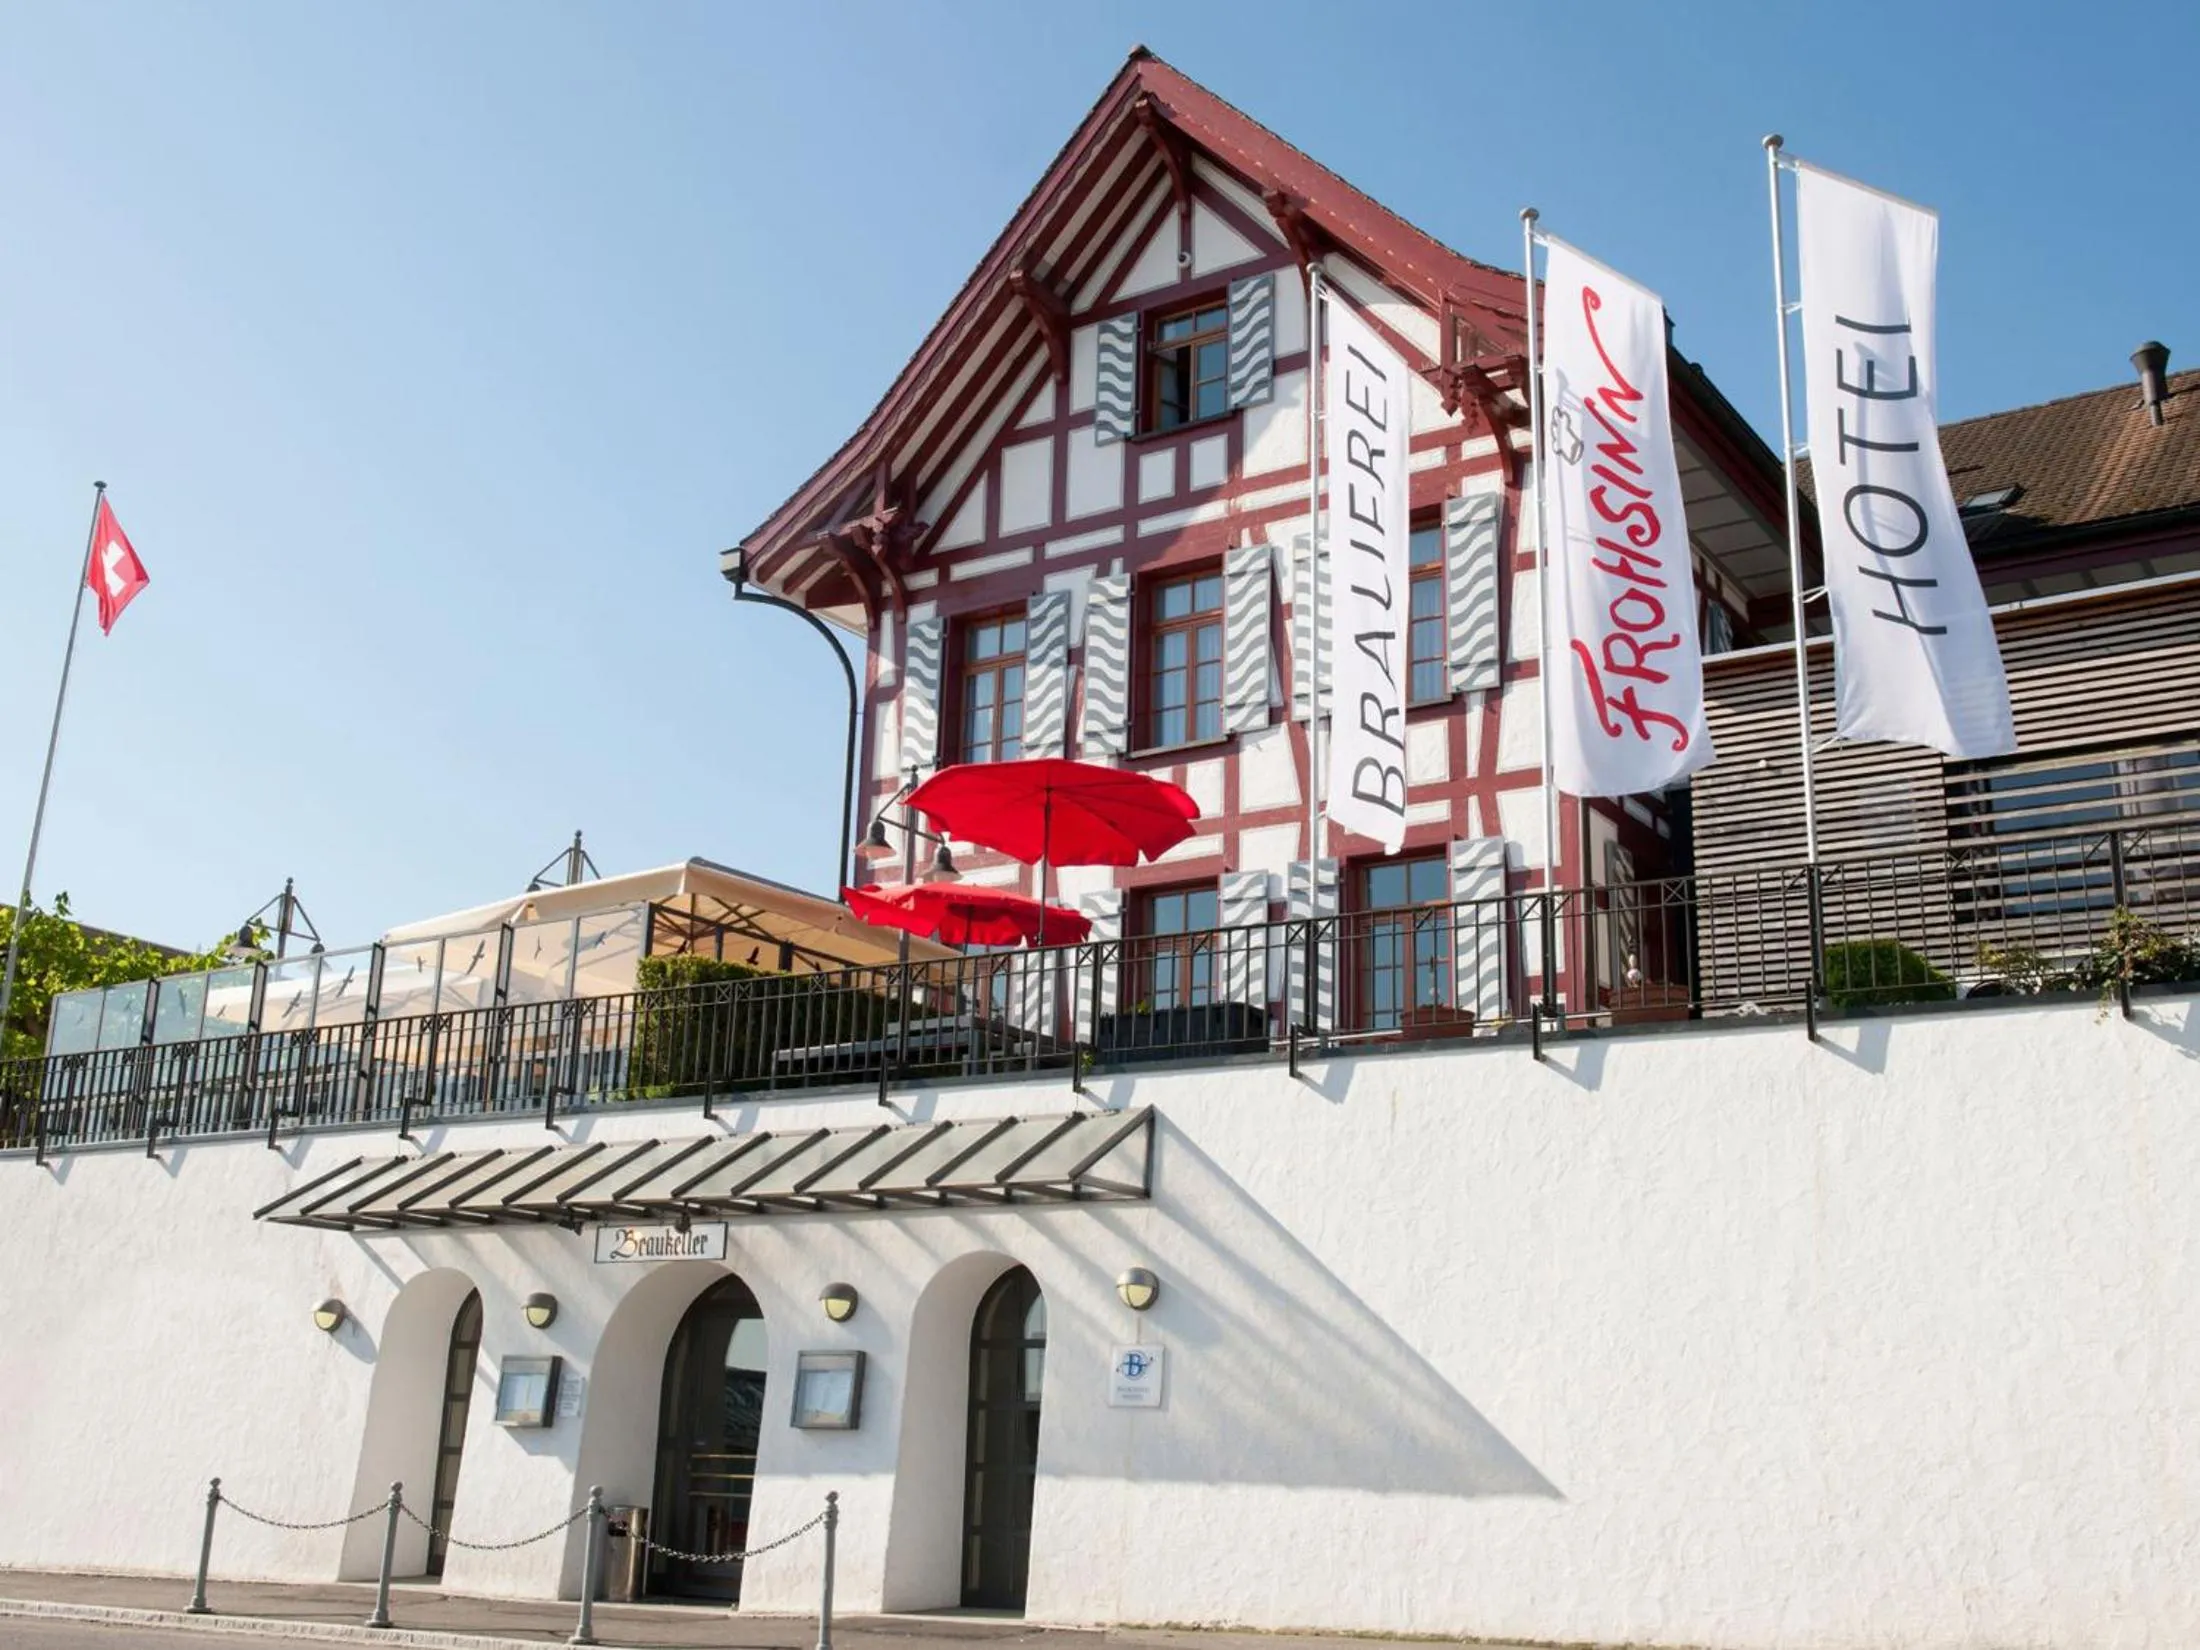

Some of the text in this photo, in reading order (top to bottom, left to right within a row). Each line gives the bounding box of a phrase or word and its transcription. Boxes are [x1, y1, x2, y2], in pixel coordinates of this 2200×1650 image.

[1346, 344, 1405, 818] BRAUEREI
[1571, 286, 1688, 751] FROHSINN
[1835, 315, 1947, 635] HOTEL
[610, 1228, 708, 1259] Braukeller
